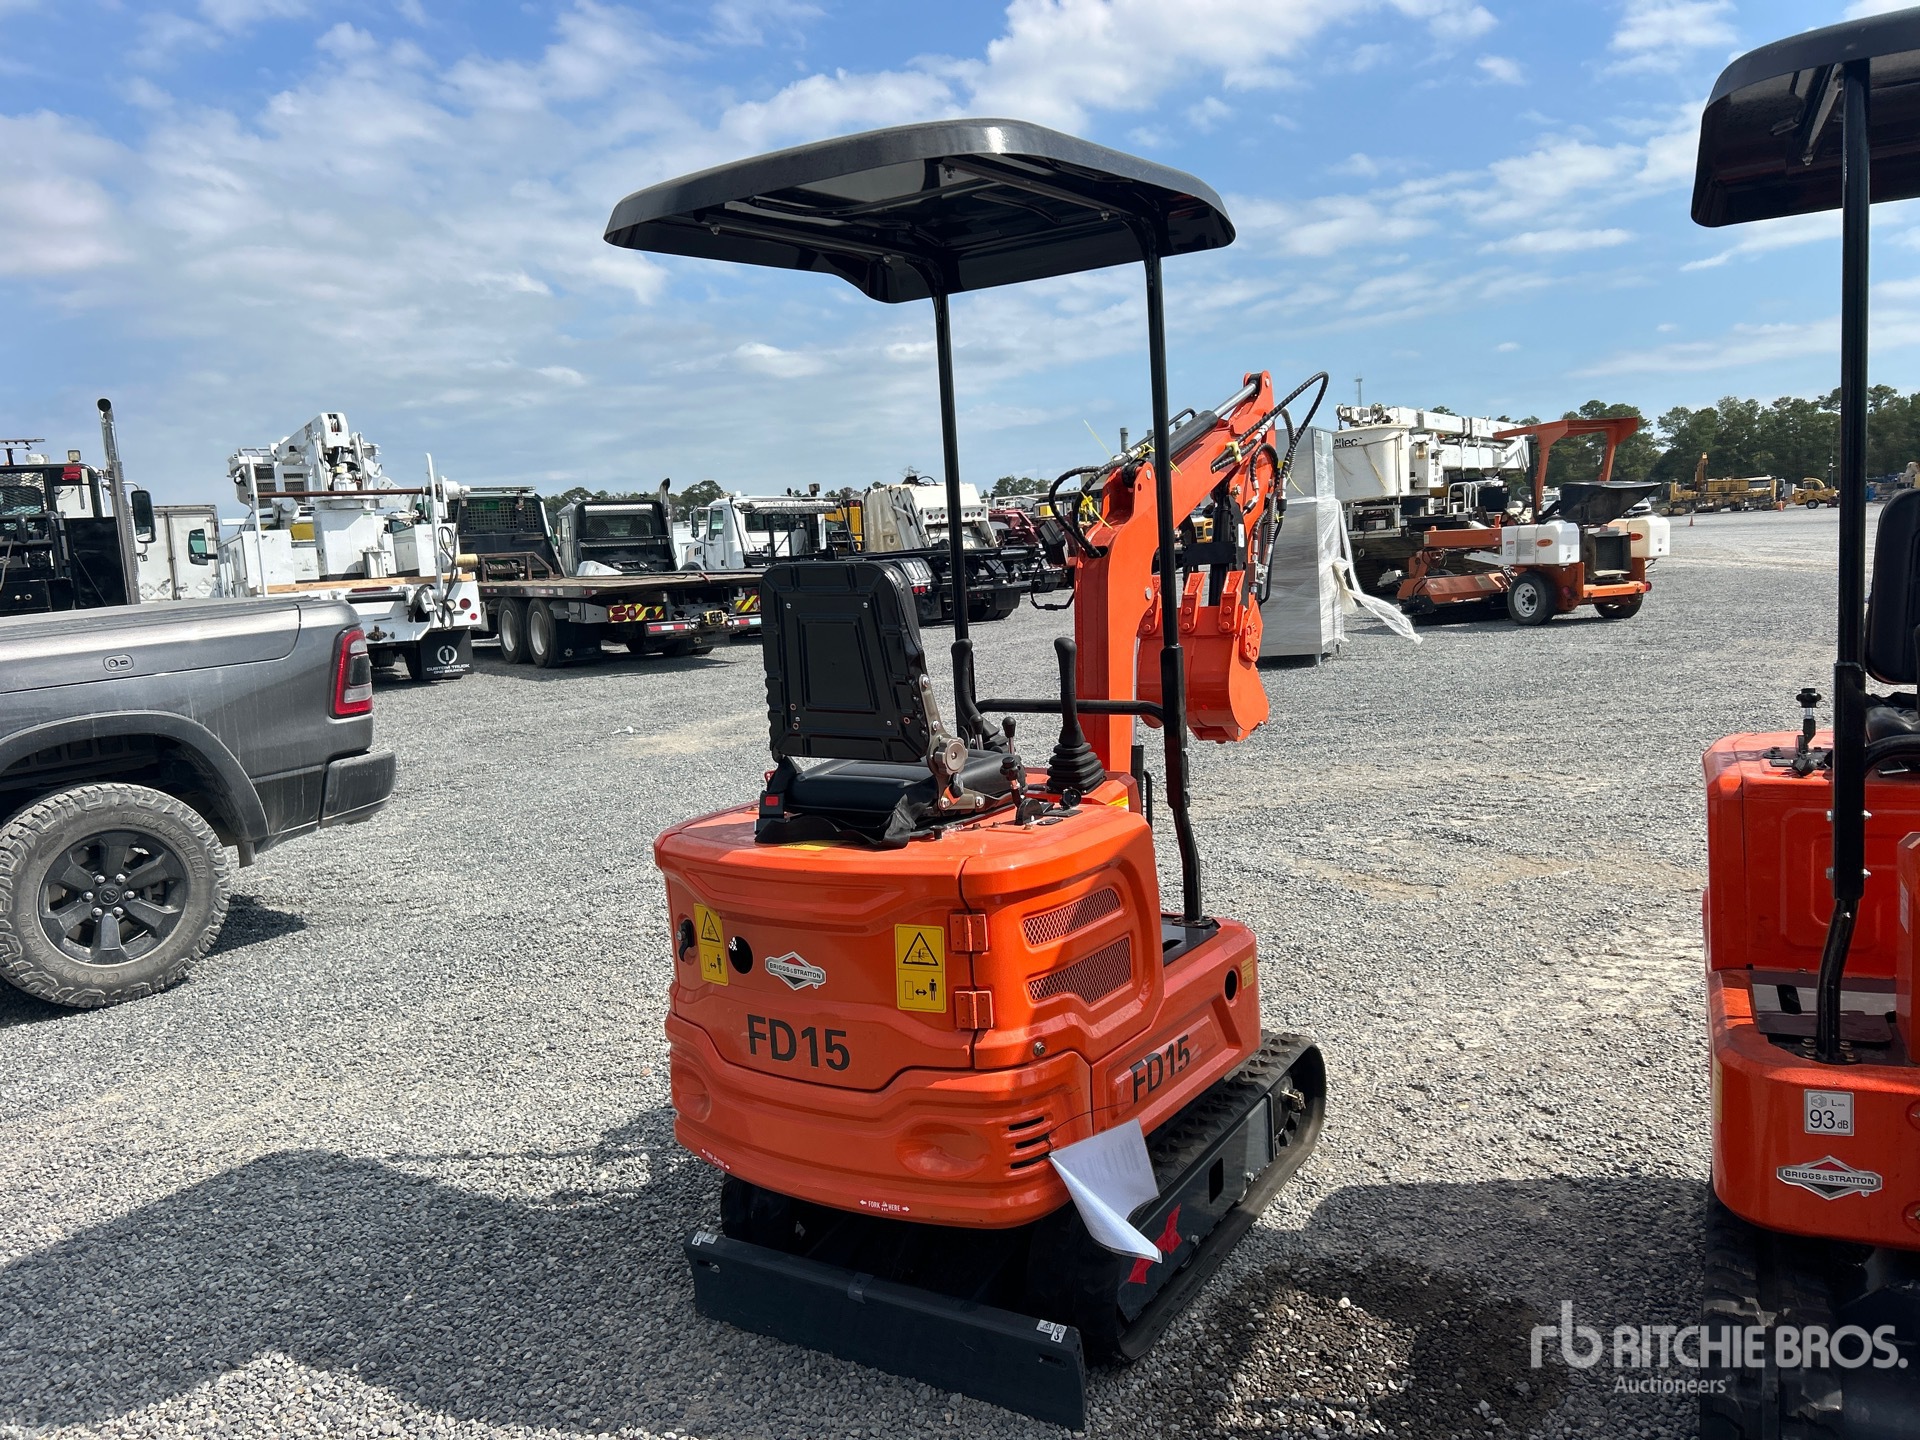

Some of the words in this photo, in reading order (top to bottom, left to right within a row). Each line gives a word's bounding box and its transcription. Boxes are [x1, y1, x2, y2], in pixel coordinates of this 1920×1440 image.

[120, 811, 208, 879] WRANGLER
[19, 912, 120, 985] GOODYEAR
[747, 1013, 851, 1072] FD15
[1129, 1033, 1191, 1105] FD15
[1810, 1109, 1836, 1129] 93
[1837, 1119, 1849, 1129] dB
[868, 1200, 881, 1209] FORK
[888, 1203, 901, 1212] HERE
